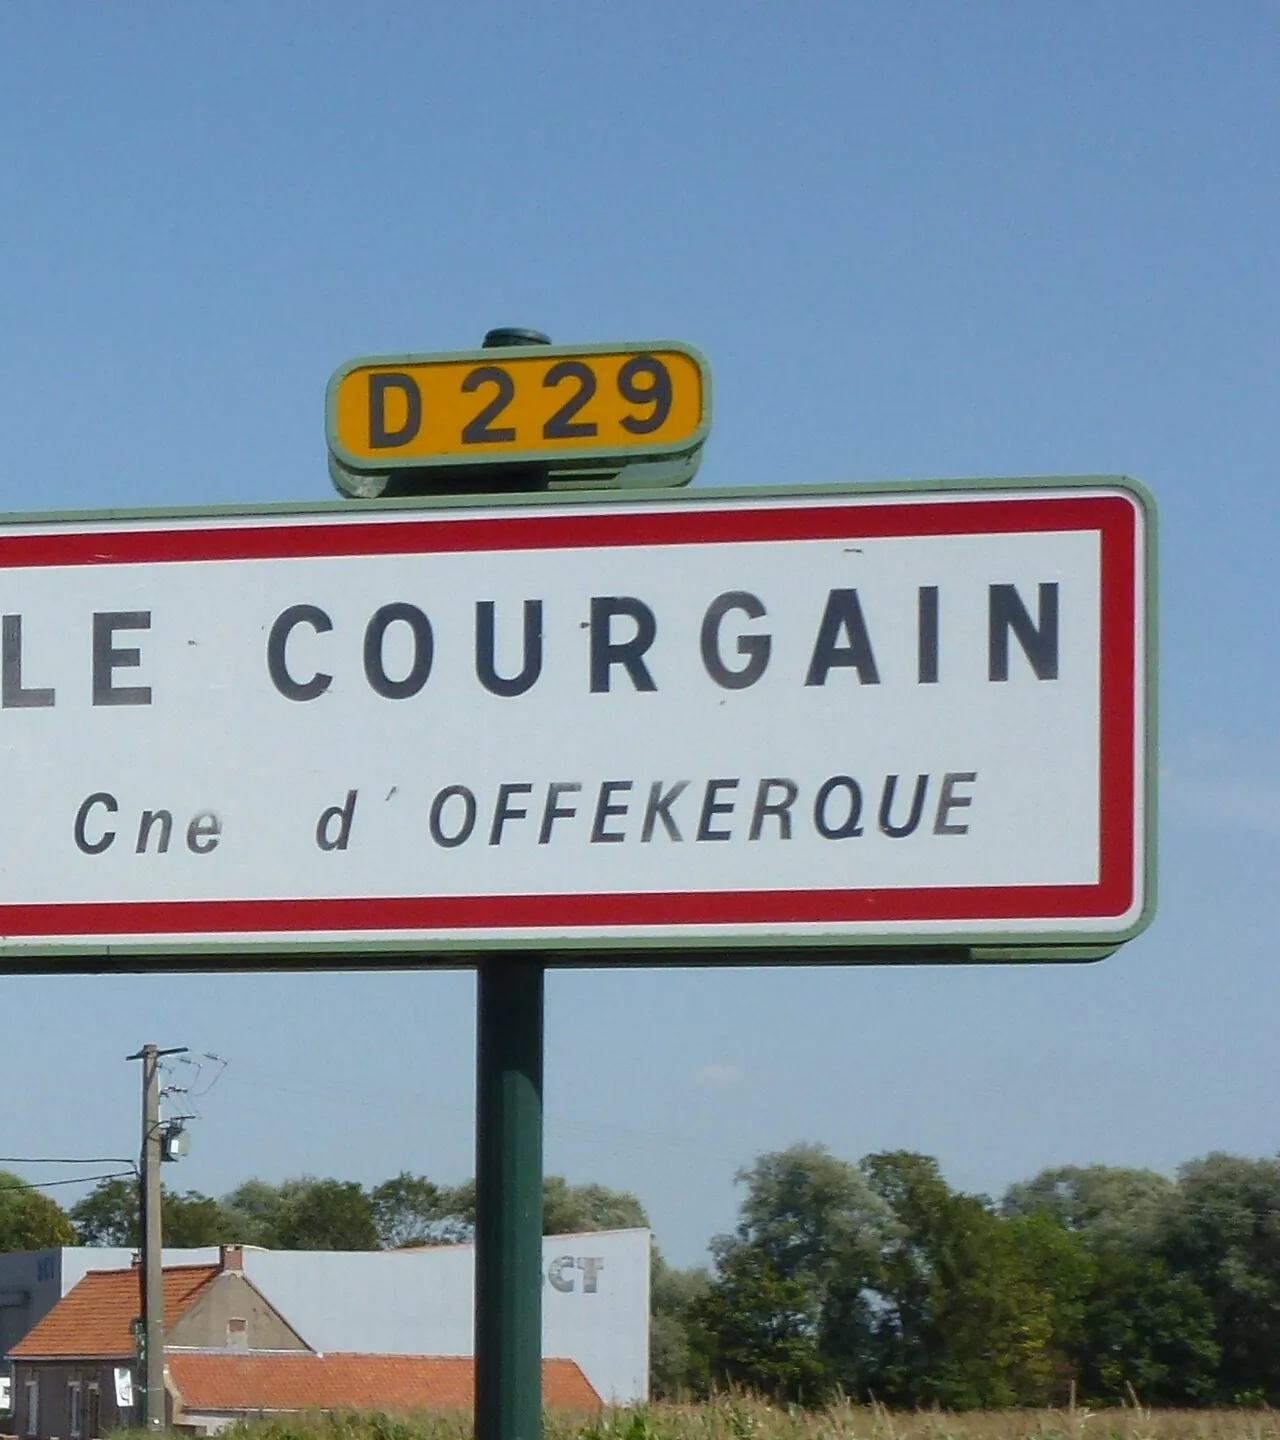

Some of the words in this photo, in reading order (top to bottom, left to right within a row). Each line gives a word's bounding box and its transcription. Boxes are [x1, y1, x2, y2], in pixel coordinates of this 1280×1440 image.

[368, 371, 423, 450] D
[459, 354, 673, 445] 229
[1, 611, 153, 709] LE
[266, 582, 1060, 702] COURGAIN
[72, 791, 223, 856] Cne
[540, 1255, 604, 1294] CT
